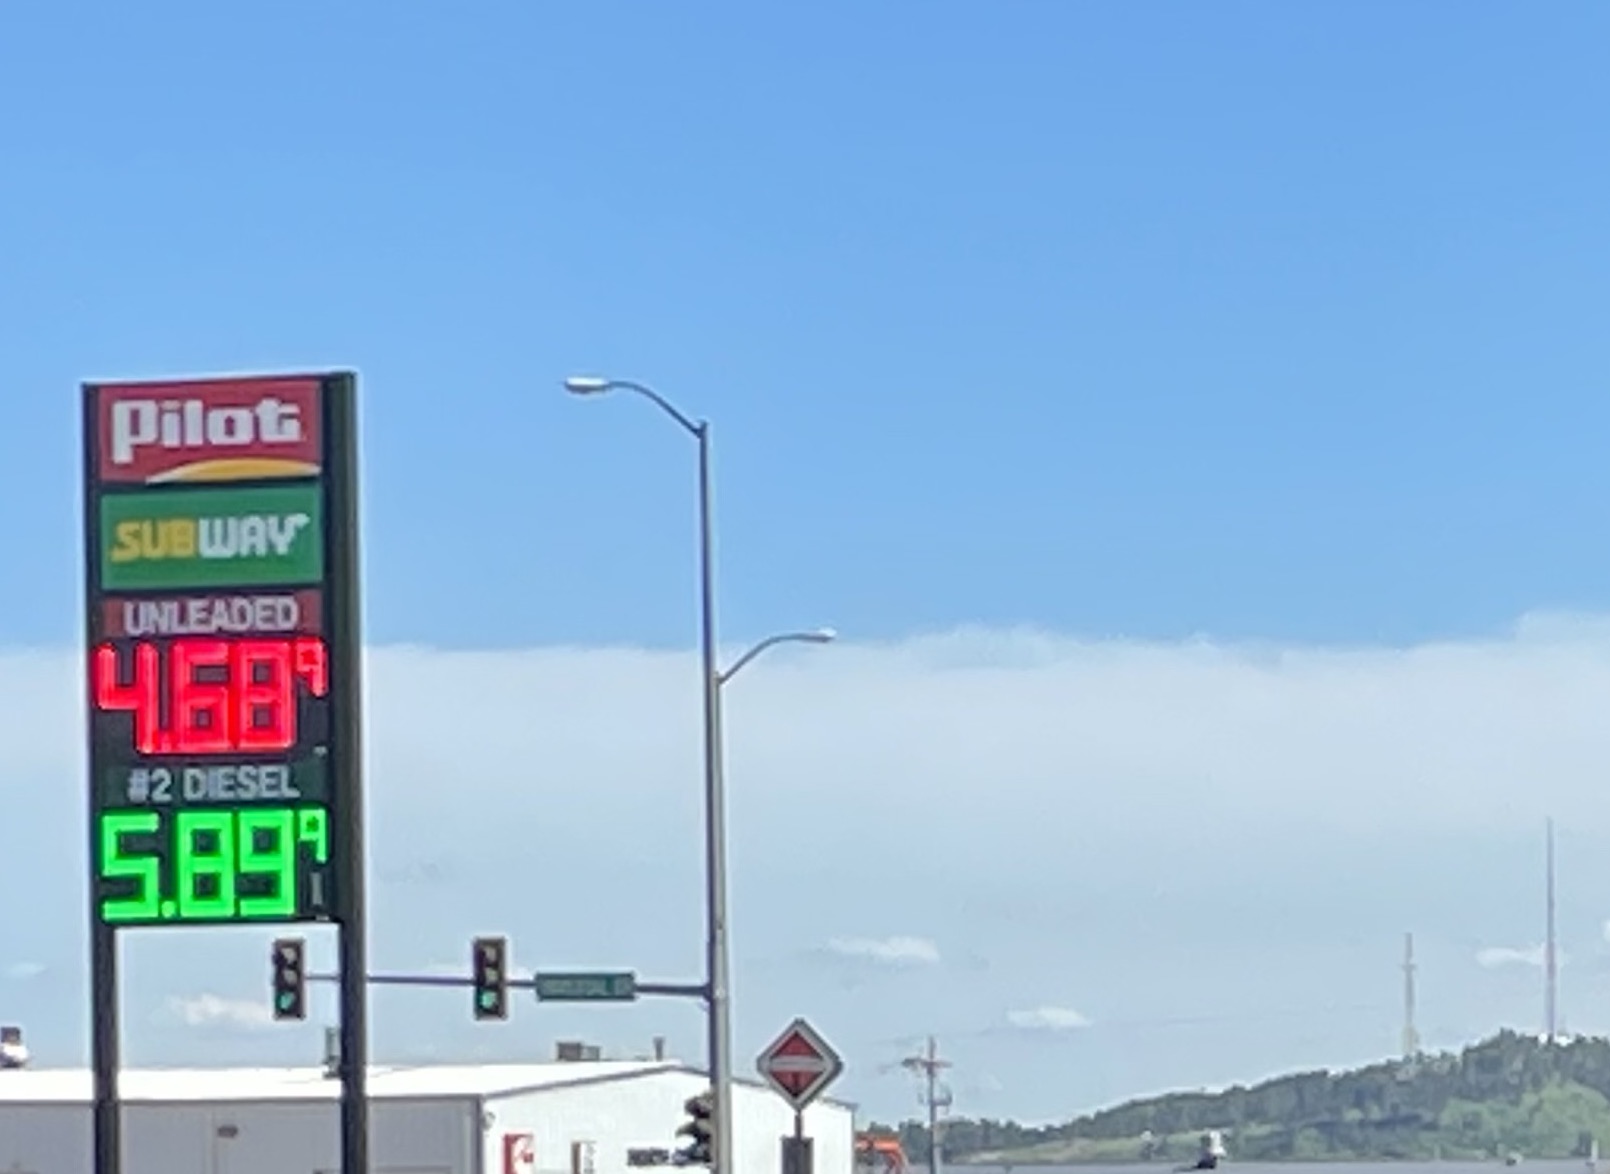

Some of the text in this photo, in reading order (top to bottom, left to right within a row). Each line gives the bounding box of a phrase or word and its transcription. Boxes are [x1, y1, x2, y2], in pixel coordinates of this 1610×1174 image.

[111, 398, 302, 464] Pilot
[110, 514, 310, 563] SUBWAY
[124, 596, 299, 636] UNLEADED
[128, 766, 299, 802] #2 DIESEL
